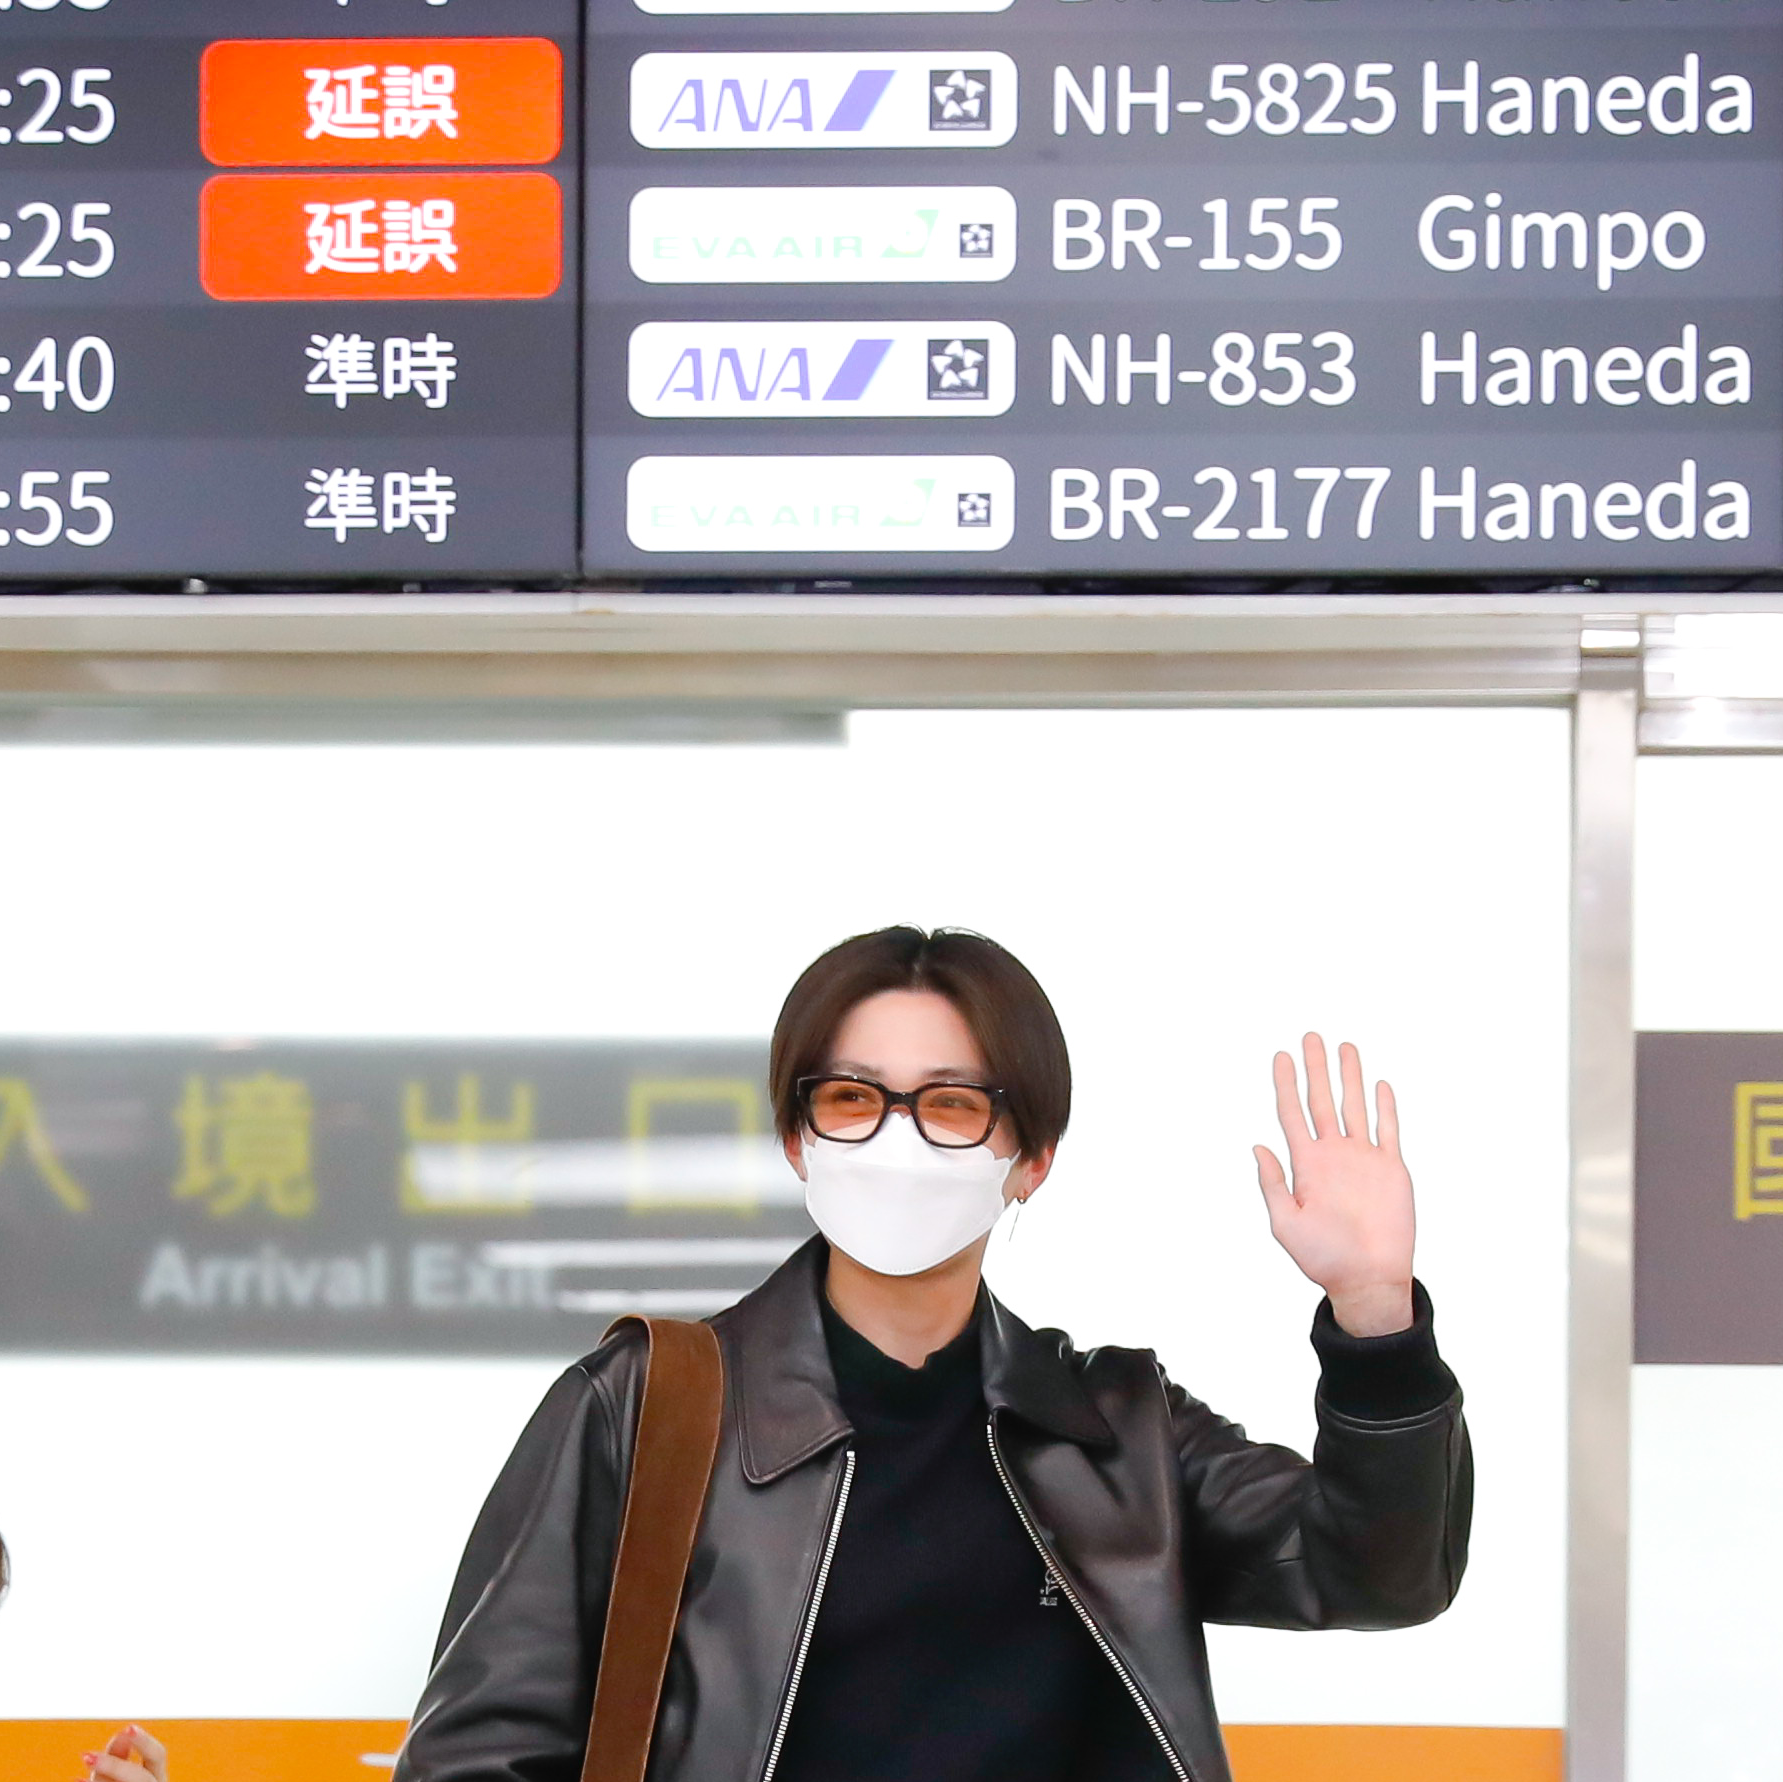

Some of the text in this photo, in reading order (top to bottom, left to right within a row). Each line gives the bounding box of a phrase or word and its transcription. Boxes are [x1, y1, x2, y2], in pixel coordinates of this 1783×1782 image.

[304, 64, 458, 139] 延誤
[659, 79, 812, 131] ANA
[1055, 54, 1751, 135] NH-5825 Haneda
[304, 198, 458, 274] 延誤
[1053, 193, 1704, 290] BR-155 Gimpo
[306, 334, 456, 407] 準時
[658, 348, 810, 401] ANA
[1053, 325, 1749, 405] NH-853 Haneda
[306, 468, 455, 542] 準時
[1051, 460, 1749, 540] BR-2177 Haneda
[139, 1242, 388, 1308] Arrival
